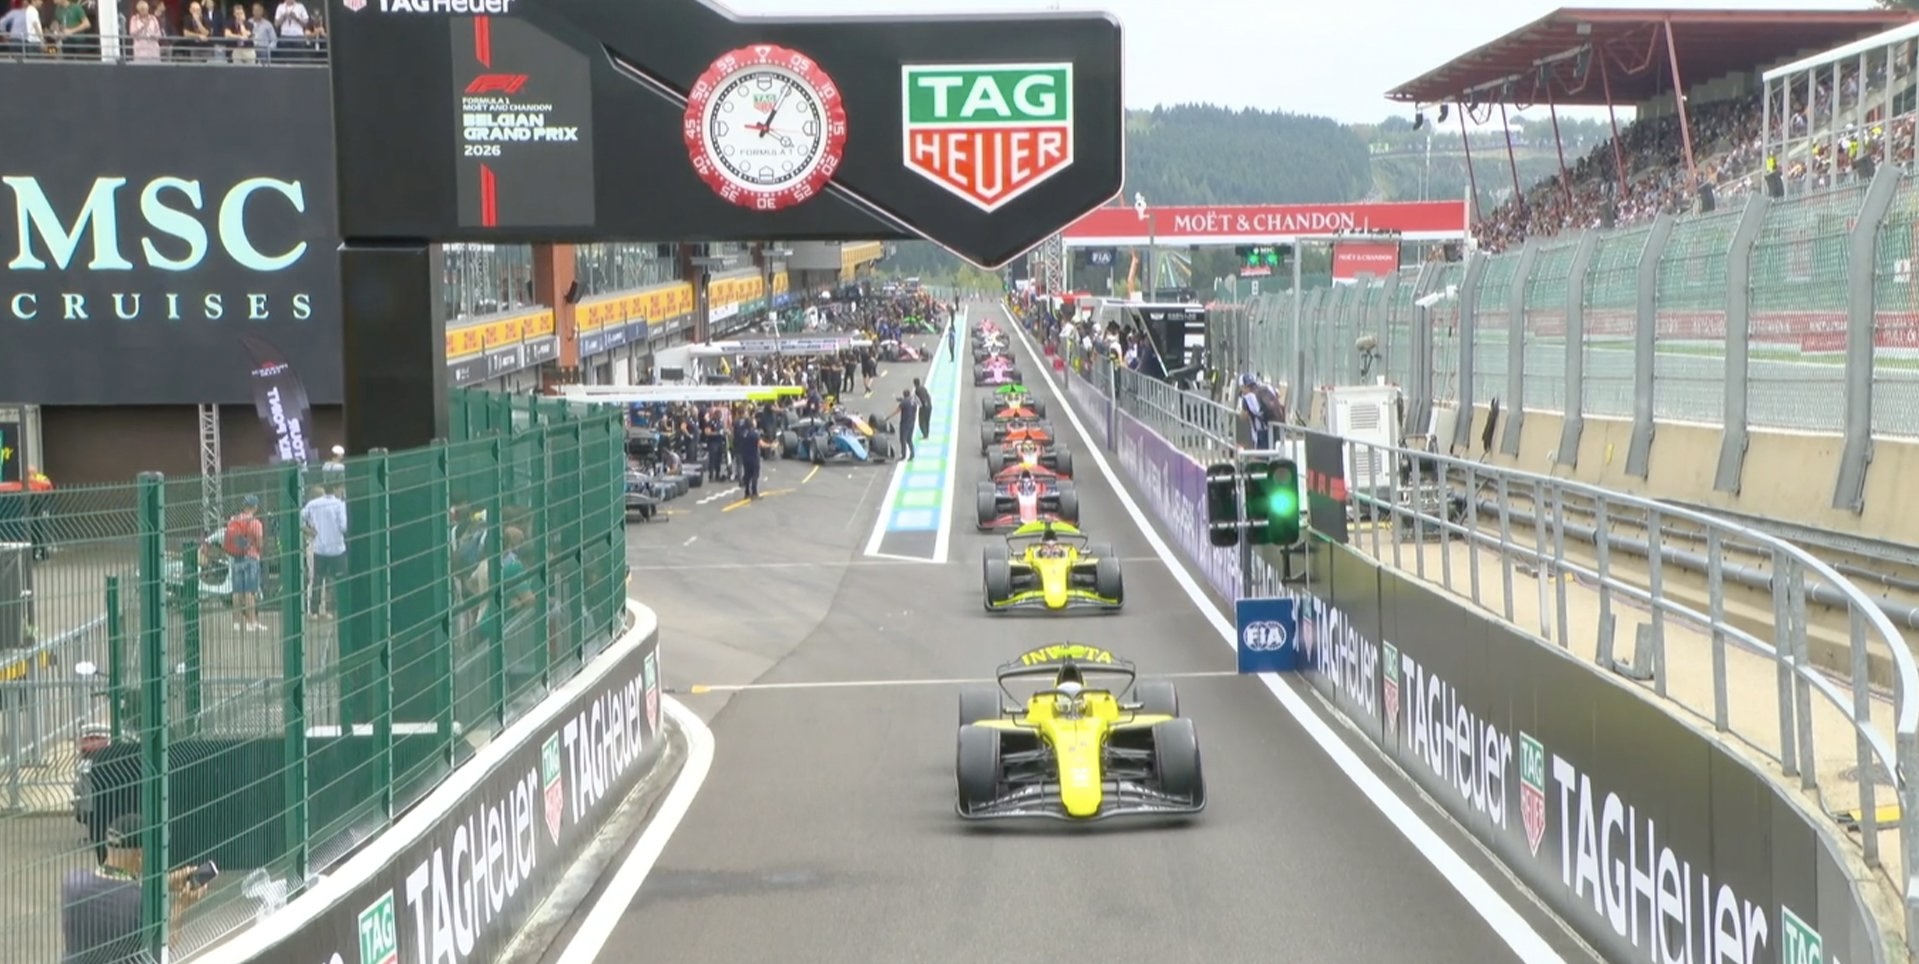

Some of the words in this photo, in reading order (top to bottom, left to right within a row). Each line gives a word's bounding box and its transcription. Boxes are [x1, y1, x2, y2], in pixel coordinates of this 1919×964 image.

[717, 55, 736, 70] 55
[790, 55, 810, 72] 05
[692, 81, 708, 100] 50
[821, 83, 836, 99] 10
[917, 74, 1057, 118] TAG
[462, 97, 503, 105] FORMULA
[463, 113, 545, 127] BELGIAN
[685, 119, 696, 139] 45
[834, 121, 845, 135] 15
[463, 127, 531, 141] GRAND
[533, 127, 578, 141] PRIX
[464, 144, 501, 156] 2026
[693, 157, 709, 175] 40
[821, 155, 838, 176] 20
[915, 131, 1061, 199] HEUER
[720, 186, 739, 202] 35
[793, 185, 813, 202] 25
[757, 198, 776, 209] 30
[2, 176, 307, 271] MSC
[1174, 211, 1232, 232] MOËT
[1236, 215, 1250, 230] &
[1254, 212, 1354, 230] CHANDON
[11, 293, 311, 319] CRUISES
[1245, 624, 1284, 647] FIA
[1521, 741, 1542, 786] TAG
[362, 901, 394, 964] TAG
